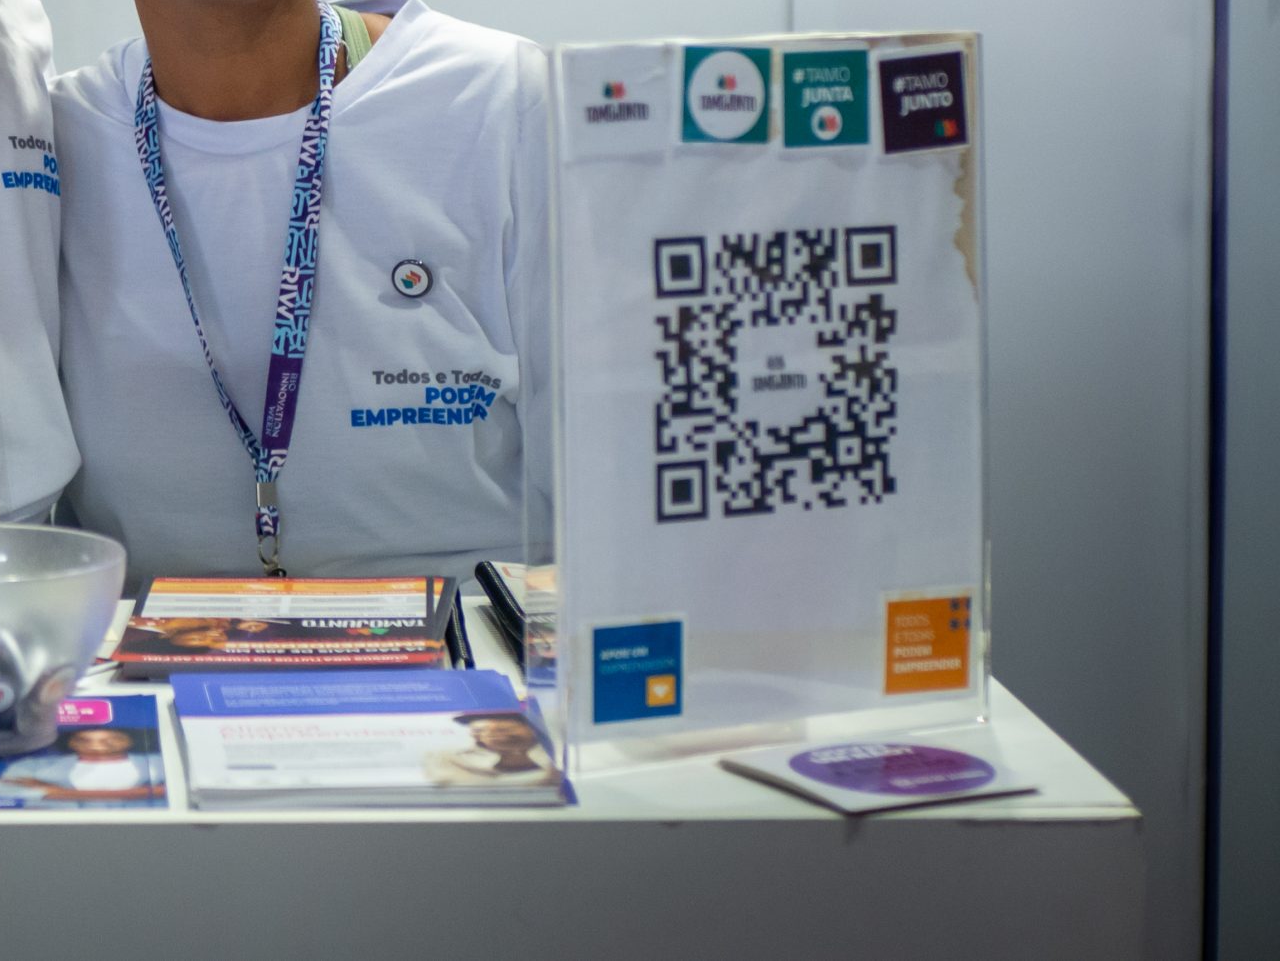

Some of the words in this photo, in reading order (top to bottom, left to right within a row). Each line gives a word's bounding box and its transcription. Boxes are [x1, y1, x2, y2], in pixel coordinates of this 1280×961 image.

[801, 87, 853, 107] JUNTA
[900, 92, 953, 116] JUNTO
[372, 369, 431, 385] Todos
[435, 372, 447, 384] e
[451, 370, 502, 390] Todas
[272, 371, 290, 438] INNOVATION
